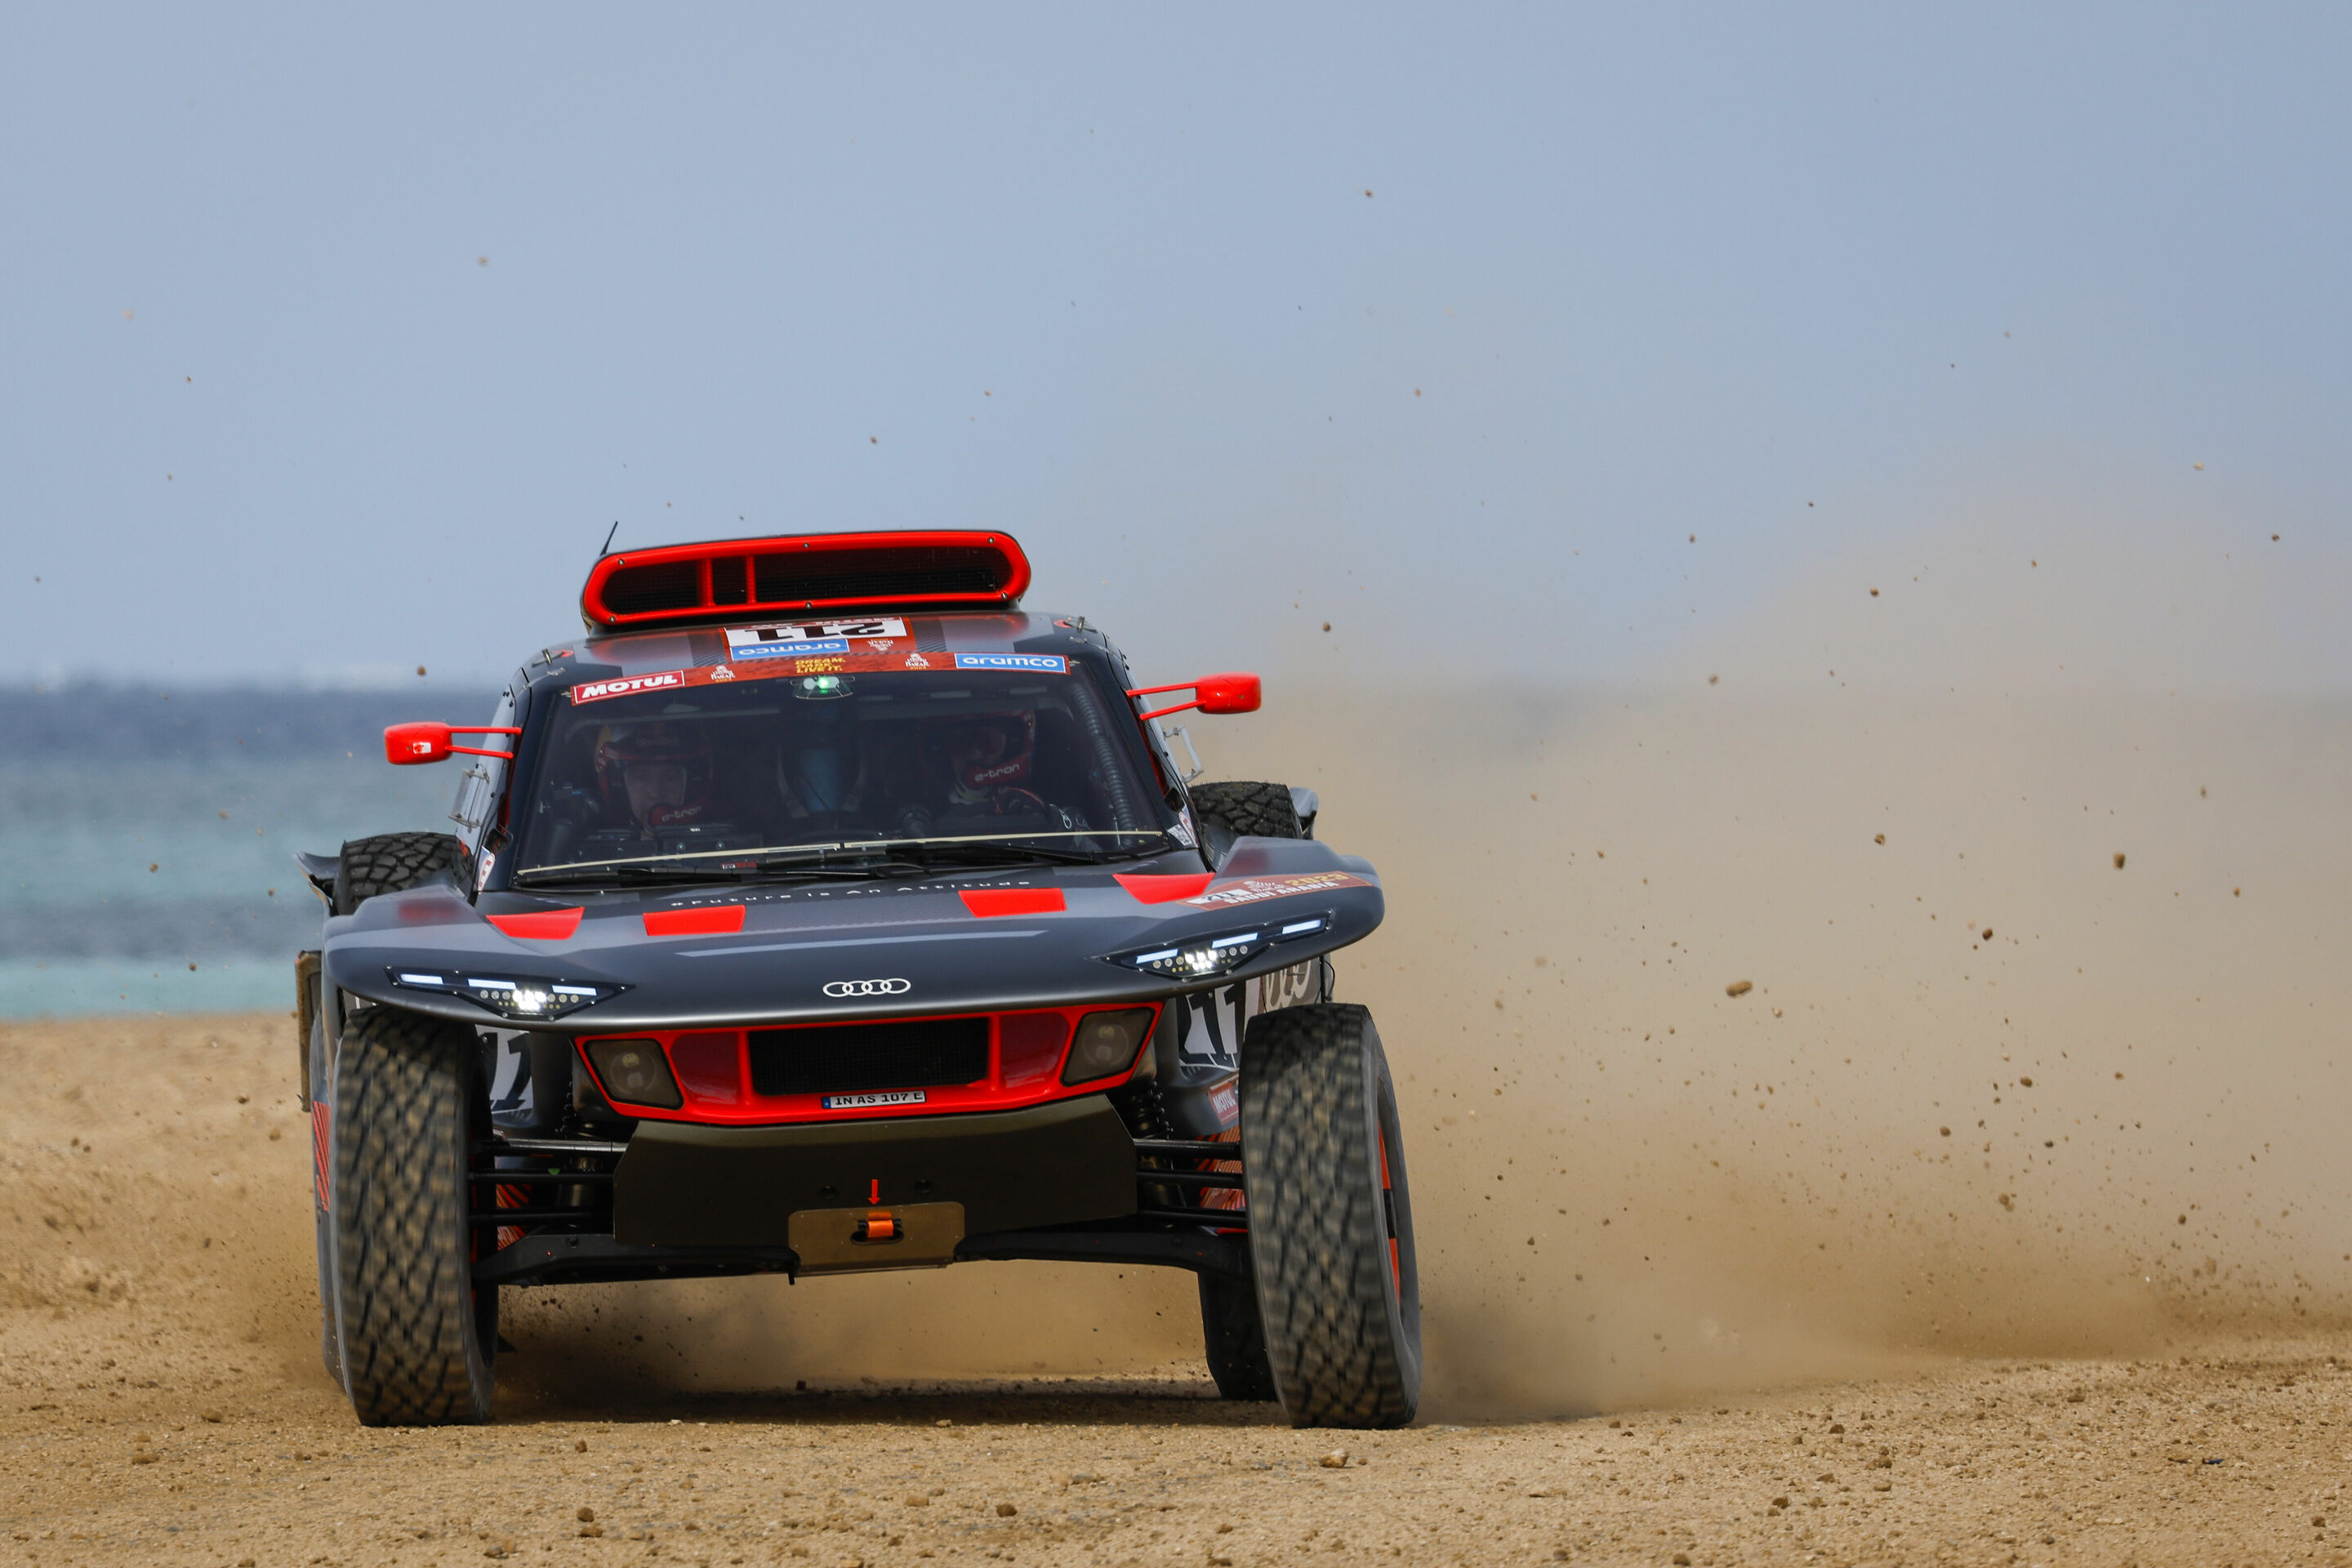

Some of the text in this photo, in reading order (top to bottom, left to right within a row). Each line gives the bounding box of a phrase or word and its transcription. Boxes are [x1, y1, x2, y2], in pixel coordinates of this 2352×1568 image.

[744, 621, 885, 642] 211
[738, 643, 841, 655] aramco
[962, 657, 1058, 668] aramco
[581, 675, 679, 700] MOTUL
[974, 764, 1020, 782] e-tron
[1285, 873, 1348, 886] 2023
[1225, 881, 1339, 904] SAUDI ARABIA
[835, 1092, 924, 1106] IN AS 107 E
[1213, 1089, 1236, 1114] MOTUL
